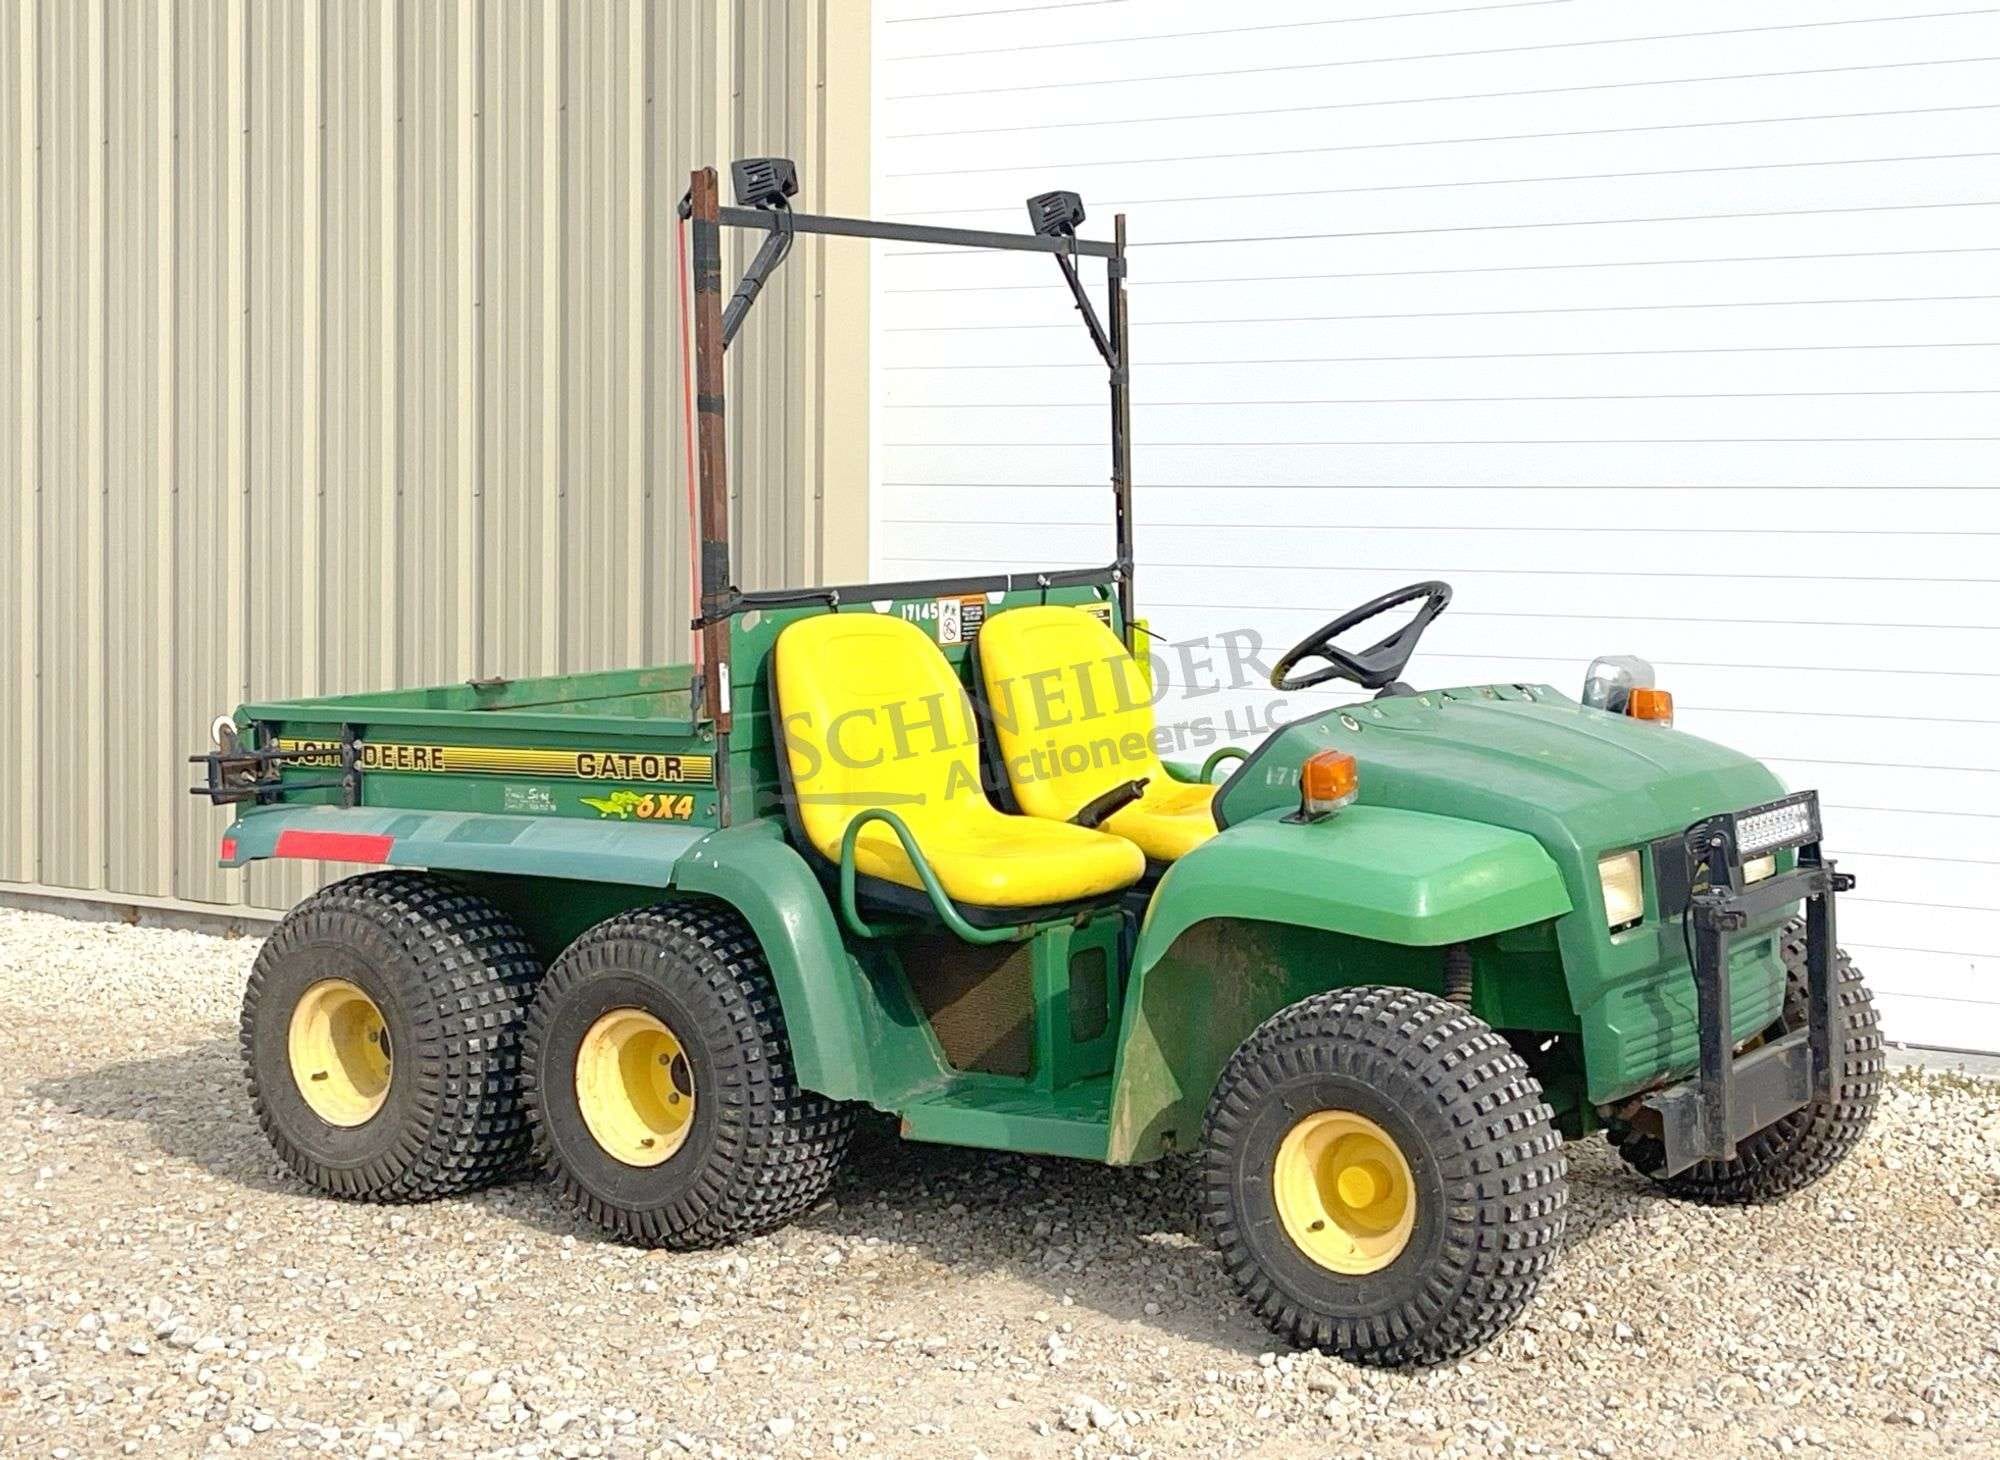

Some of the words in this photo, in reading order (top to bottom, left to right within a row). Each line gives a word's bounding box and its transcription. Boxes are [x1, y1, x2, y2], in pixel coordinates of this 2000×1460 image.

[901, 602, 938, 621] 17145
[284, 741, 346, 766] JOH
[362, 744, 446, 771] DEERE
[576, 753, 684, 782] GATOR
[635, 794, 694, 820] 6X4
